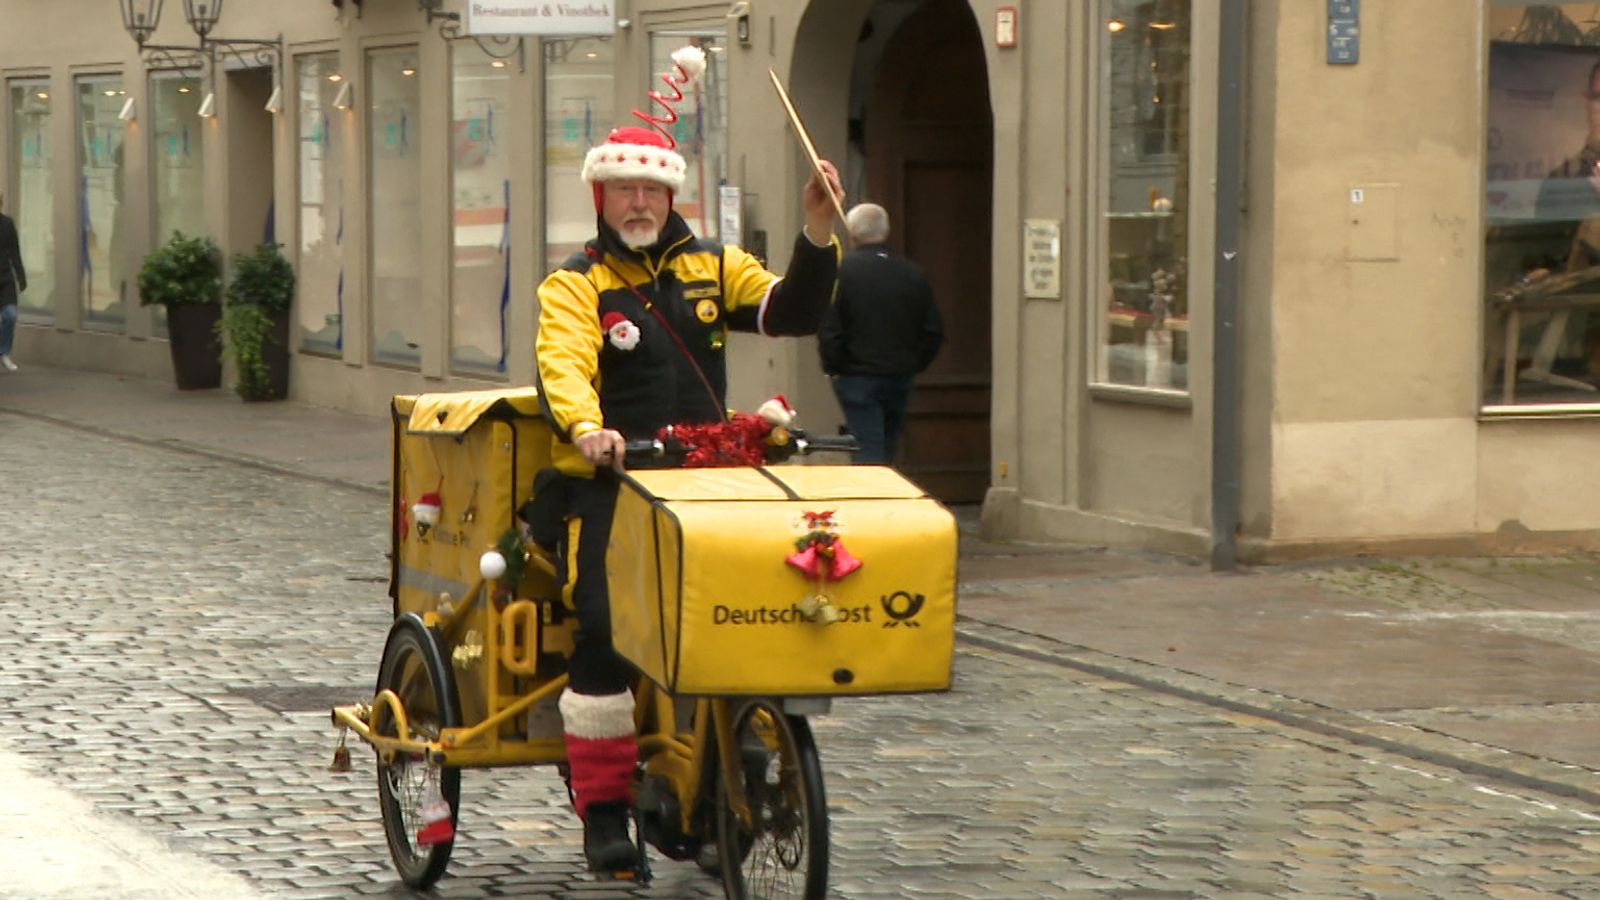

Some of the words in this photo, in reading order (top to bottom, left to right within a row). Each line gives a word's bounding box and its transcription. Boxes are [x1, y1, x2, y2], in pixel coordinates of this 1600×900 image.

[472, 4, 538, 17] Restaurant
[541, 4, 552, 17] &
[556, 4, 609, 17] Vinothek
[829, 604, 871, 623] ost
